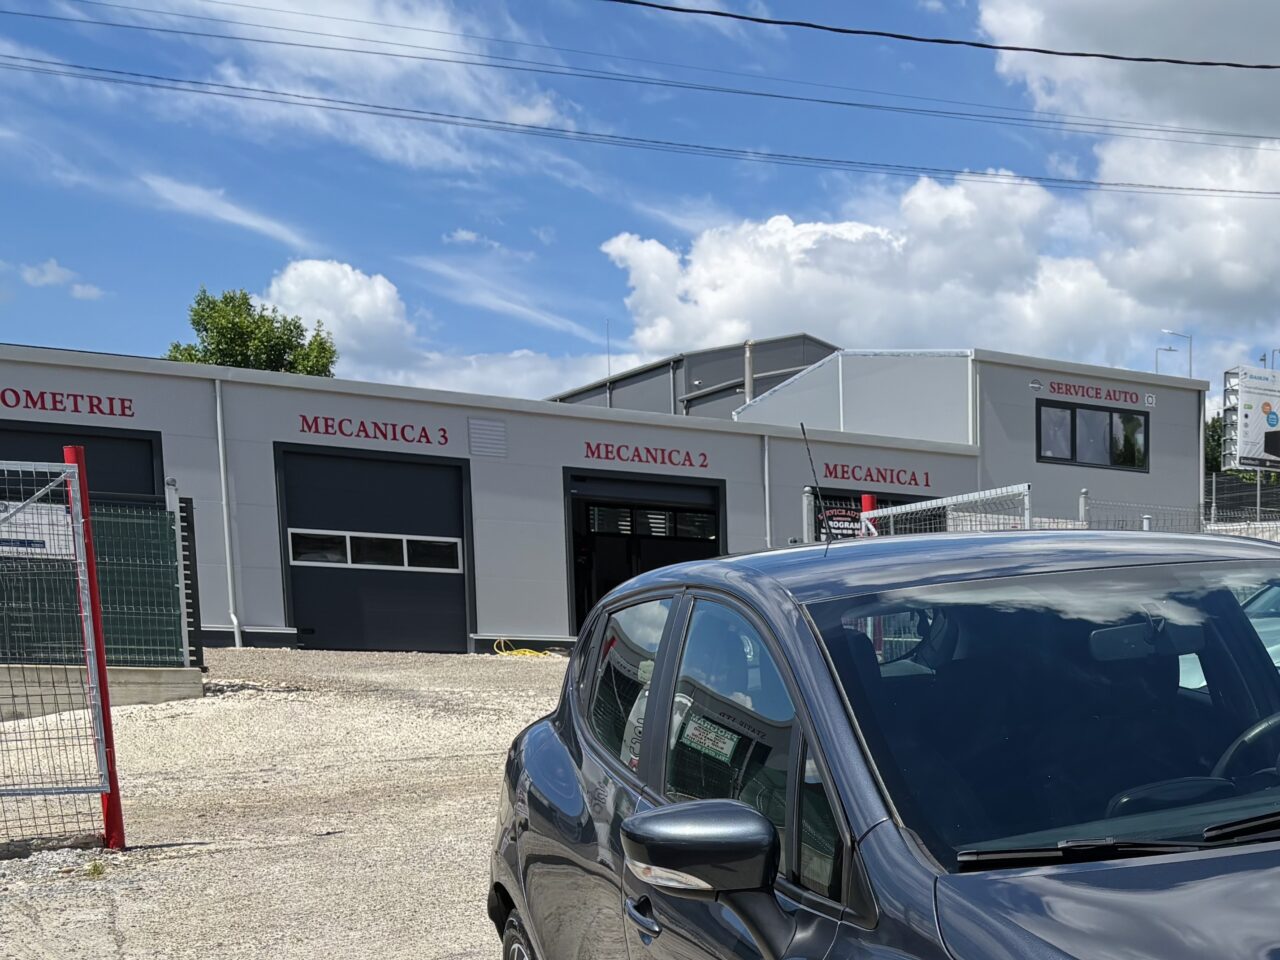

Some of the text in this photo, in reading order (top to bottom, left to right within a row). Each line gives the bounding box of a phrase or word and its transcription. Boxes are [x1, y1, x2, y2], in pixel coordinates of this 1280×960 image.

[0, 388, 135, 418] OMETRIE
[1049, 381, 1140, 404] SERVICE AUTO
[299, 414, 449, 446] MECANICA 3
[583, 441, 709, 468] MECANICA 2
[823, 462, 931, 487] MECANICA 1
[816, 508, 846, 520] SRVICE
